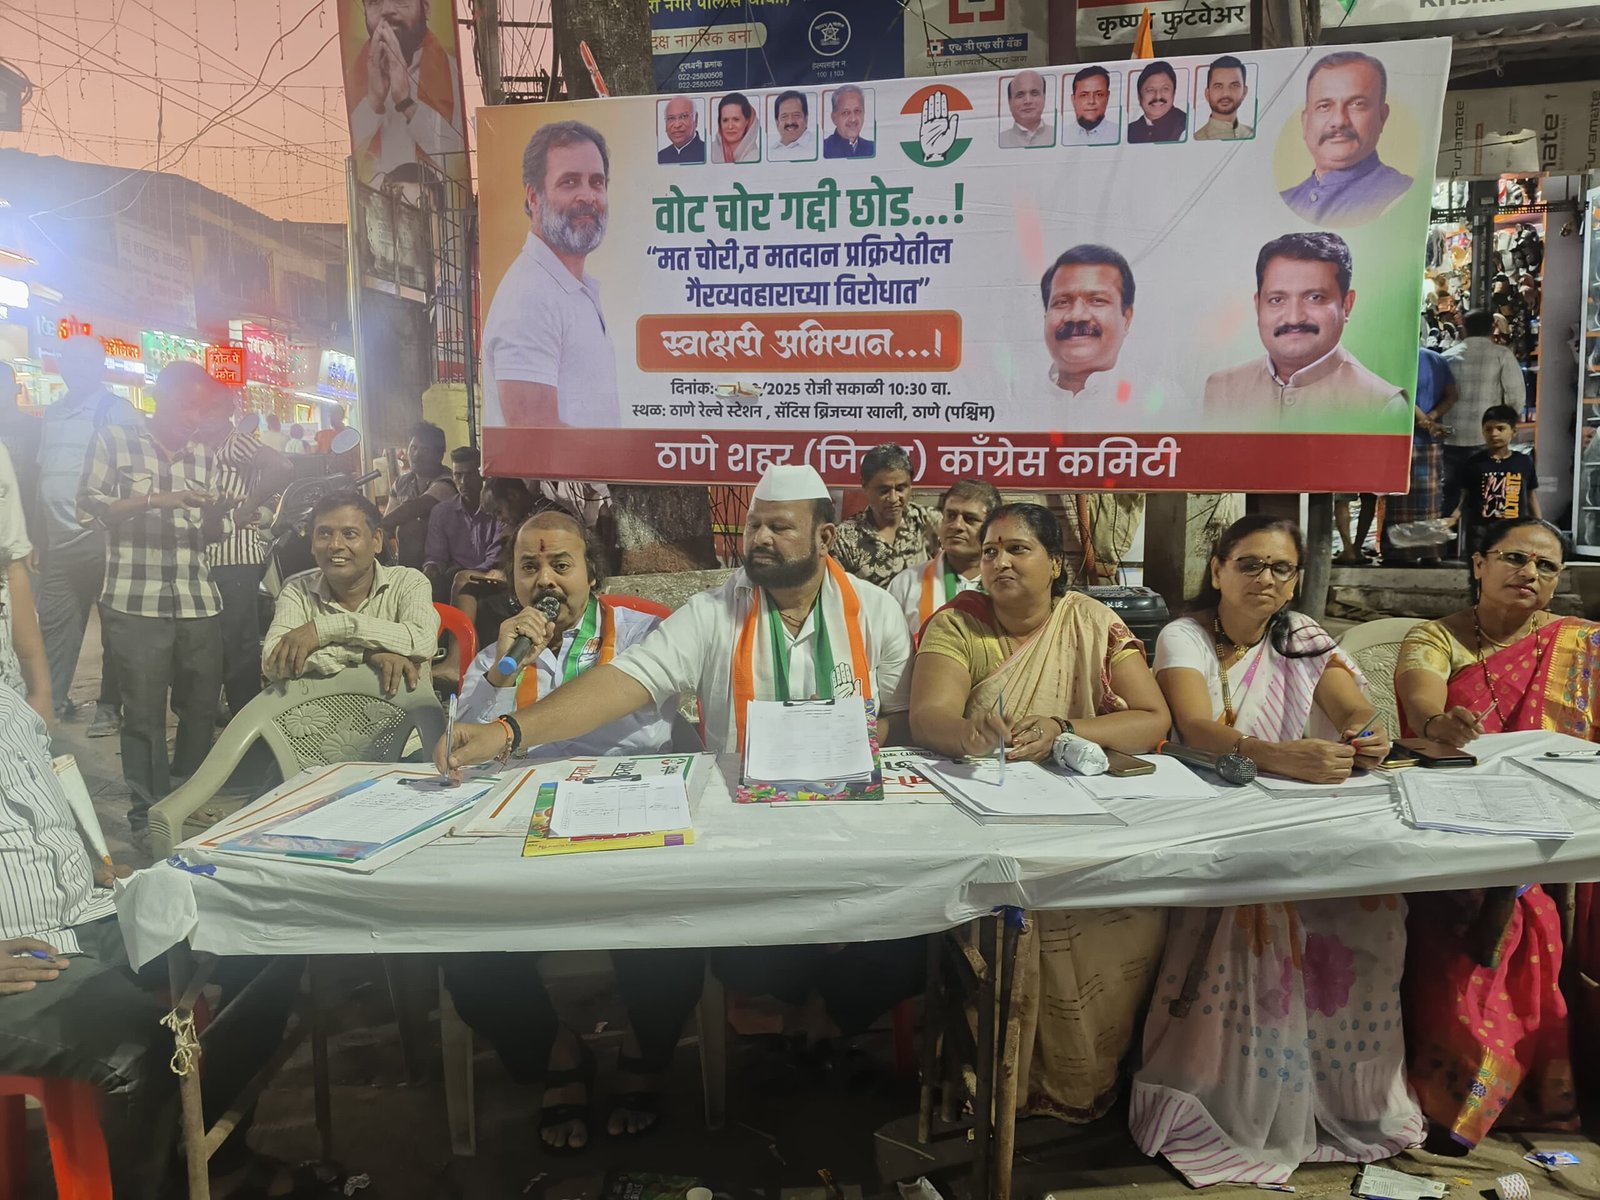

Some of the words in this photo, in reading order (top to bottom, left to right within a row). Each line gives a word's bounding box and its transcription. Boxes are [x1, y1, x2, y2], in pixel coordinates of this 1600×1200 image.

[1161, 2, 1246, 35] फुटवेअर
[675, 28, 723, 48] नागरिक
[976, 42, 991, 51] एफ
[992, 37, 1004, 49] सी
[652, 184, 708, 233] वोट
[713, 182, 774, 231] चोर
[779, 177, 840, 232] गद्दी
[764, 242, 840, 268] मतदान
[845, 231, 953, 267] प्रक्रियेतील
[686, 277, 831, 308] गैरव्यवहाराच्या
[660, 321, 765, 361] स्वाक्षरी
[671, 378, 714, 396] दिनांक:
[805, 378, 832, 396] रोजी
[836, 378, 884, 396] सकाळी
[889, 383, 927, 395] 10:30
[931, 383, 951, 396] वा.
[632, 404, 666, 418] स्थळ:
[670, 403, 696, 418] ठाणे
[698, 402, 723, 418] रेल्वे
[727, 402, 763, 418] स्टेशन
[774, 402, 810, 419] सॅटिस
[814, 402, 863, 420] ब्रिजच्या
[866, 402, 907, 421] खाली,
[911, 402, 941, 419] ठाणे
[944, 403, 995, 423] (पश्चिम)
[655, 434, 718, 471] ठाणे
[727, 443, 793, 473] शहर
[938, 433, 1049, 477] काँग्रेस
[1056, 437, 1181, 477] कमिटी
